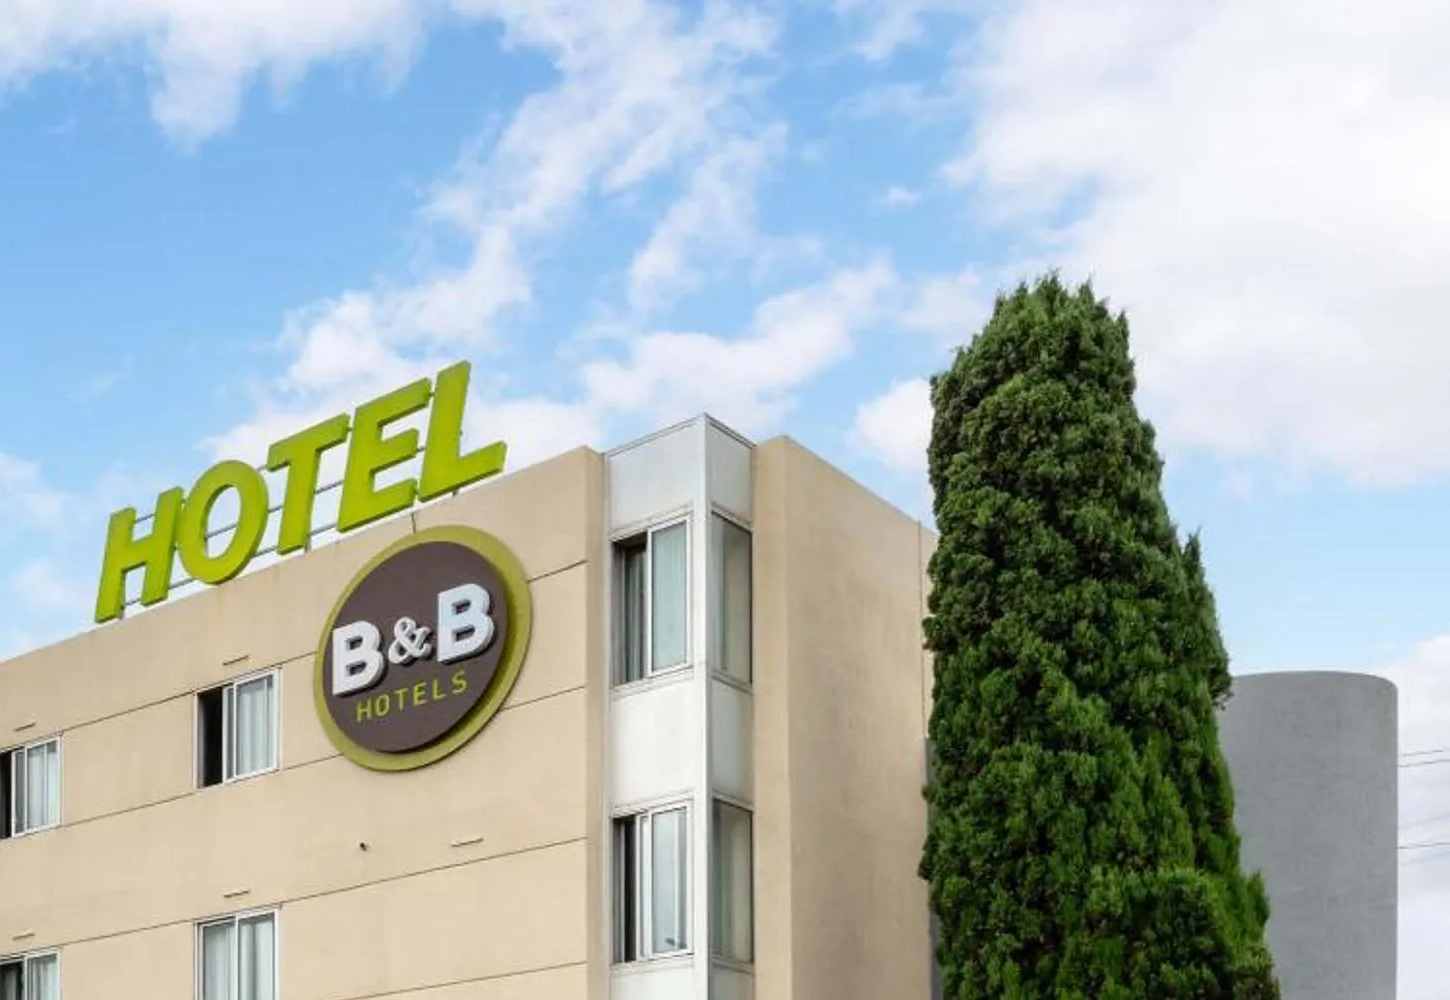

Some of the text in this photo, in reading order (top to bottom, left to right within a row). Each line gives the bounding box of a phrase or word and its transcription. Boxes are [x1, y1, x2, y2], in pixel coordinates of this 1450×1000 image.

[95, 360, 507, 623] HOTEL
[332, 583, 495, 696] B&B
[356, 670, 469, 723] HOTELS
